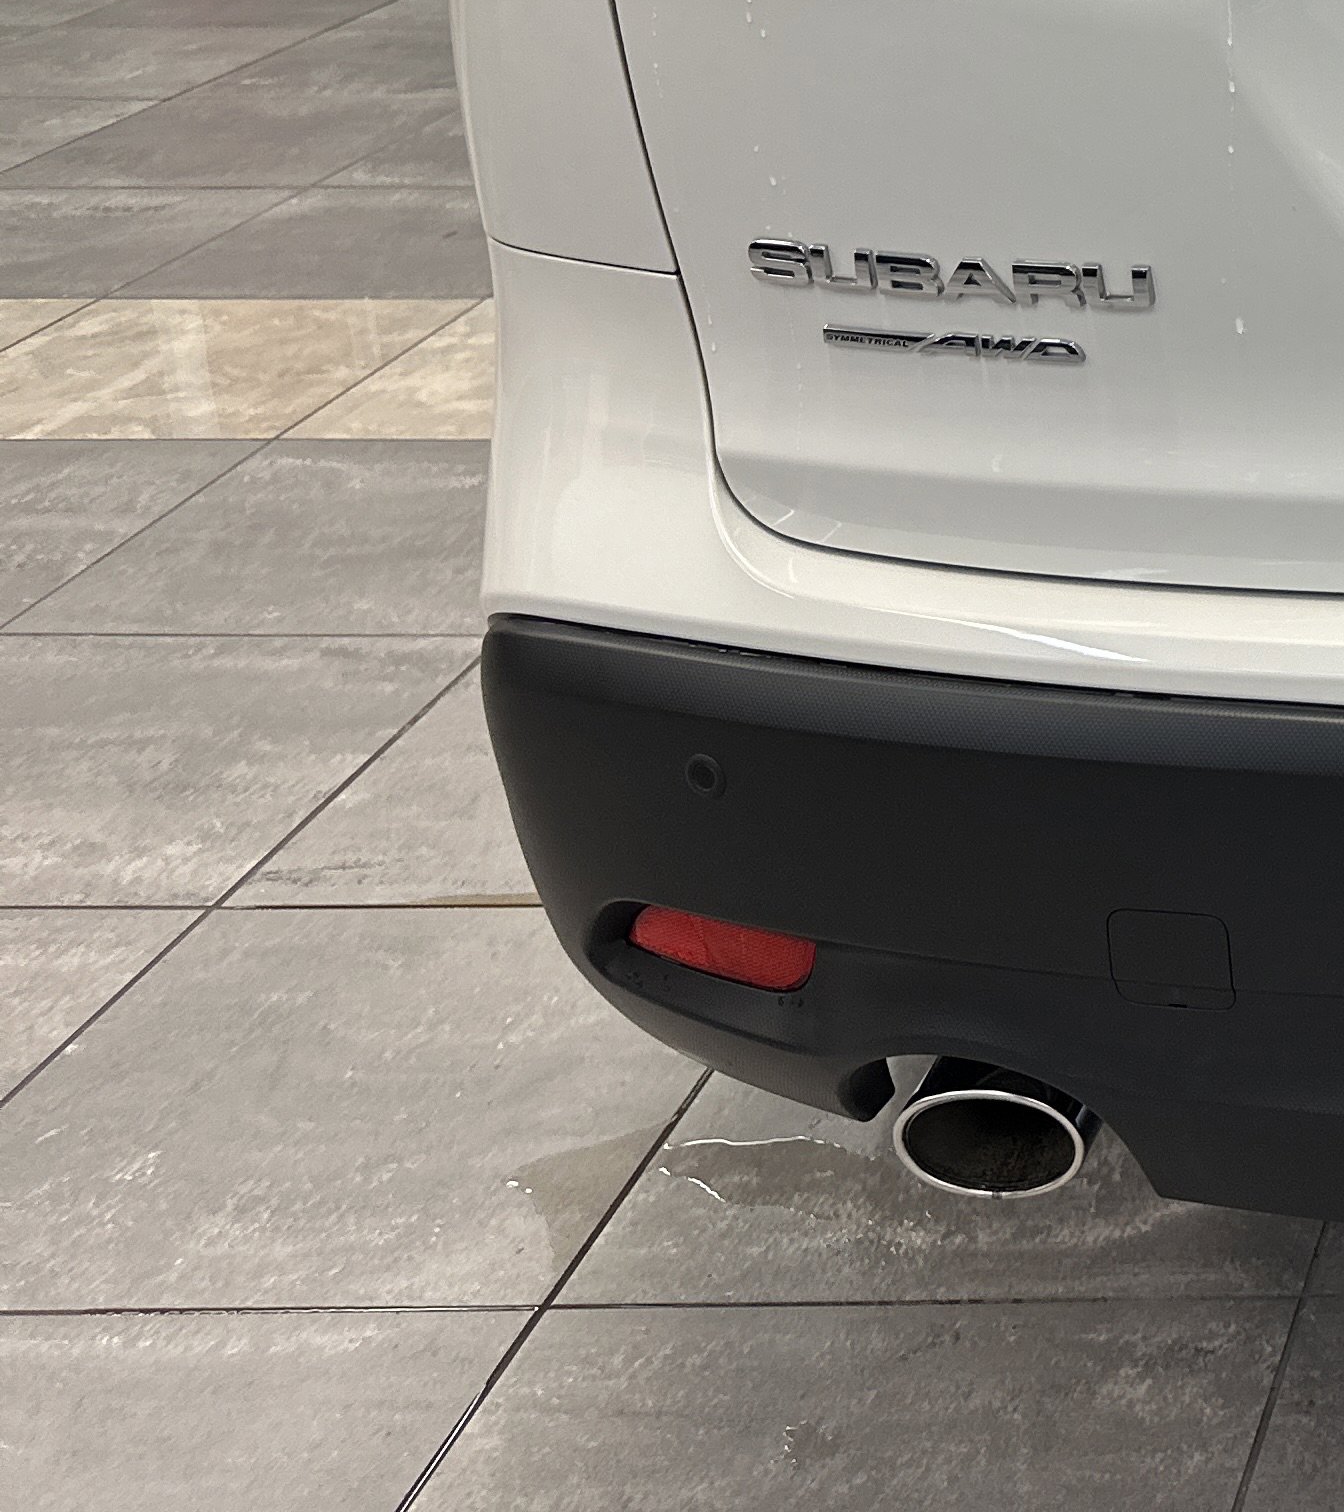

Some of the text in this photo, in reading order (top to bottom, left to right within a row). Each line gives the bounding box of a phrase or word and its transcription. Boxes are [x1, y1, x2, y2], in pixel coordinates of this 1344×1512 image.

[748, 238, 1157, 309] SUBARU
[825, 331, 1087, 363] SYMMETRICAL AWD
